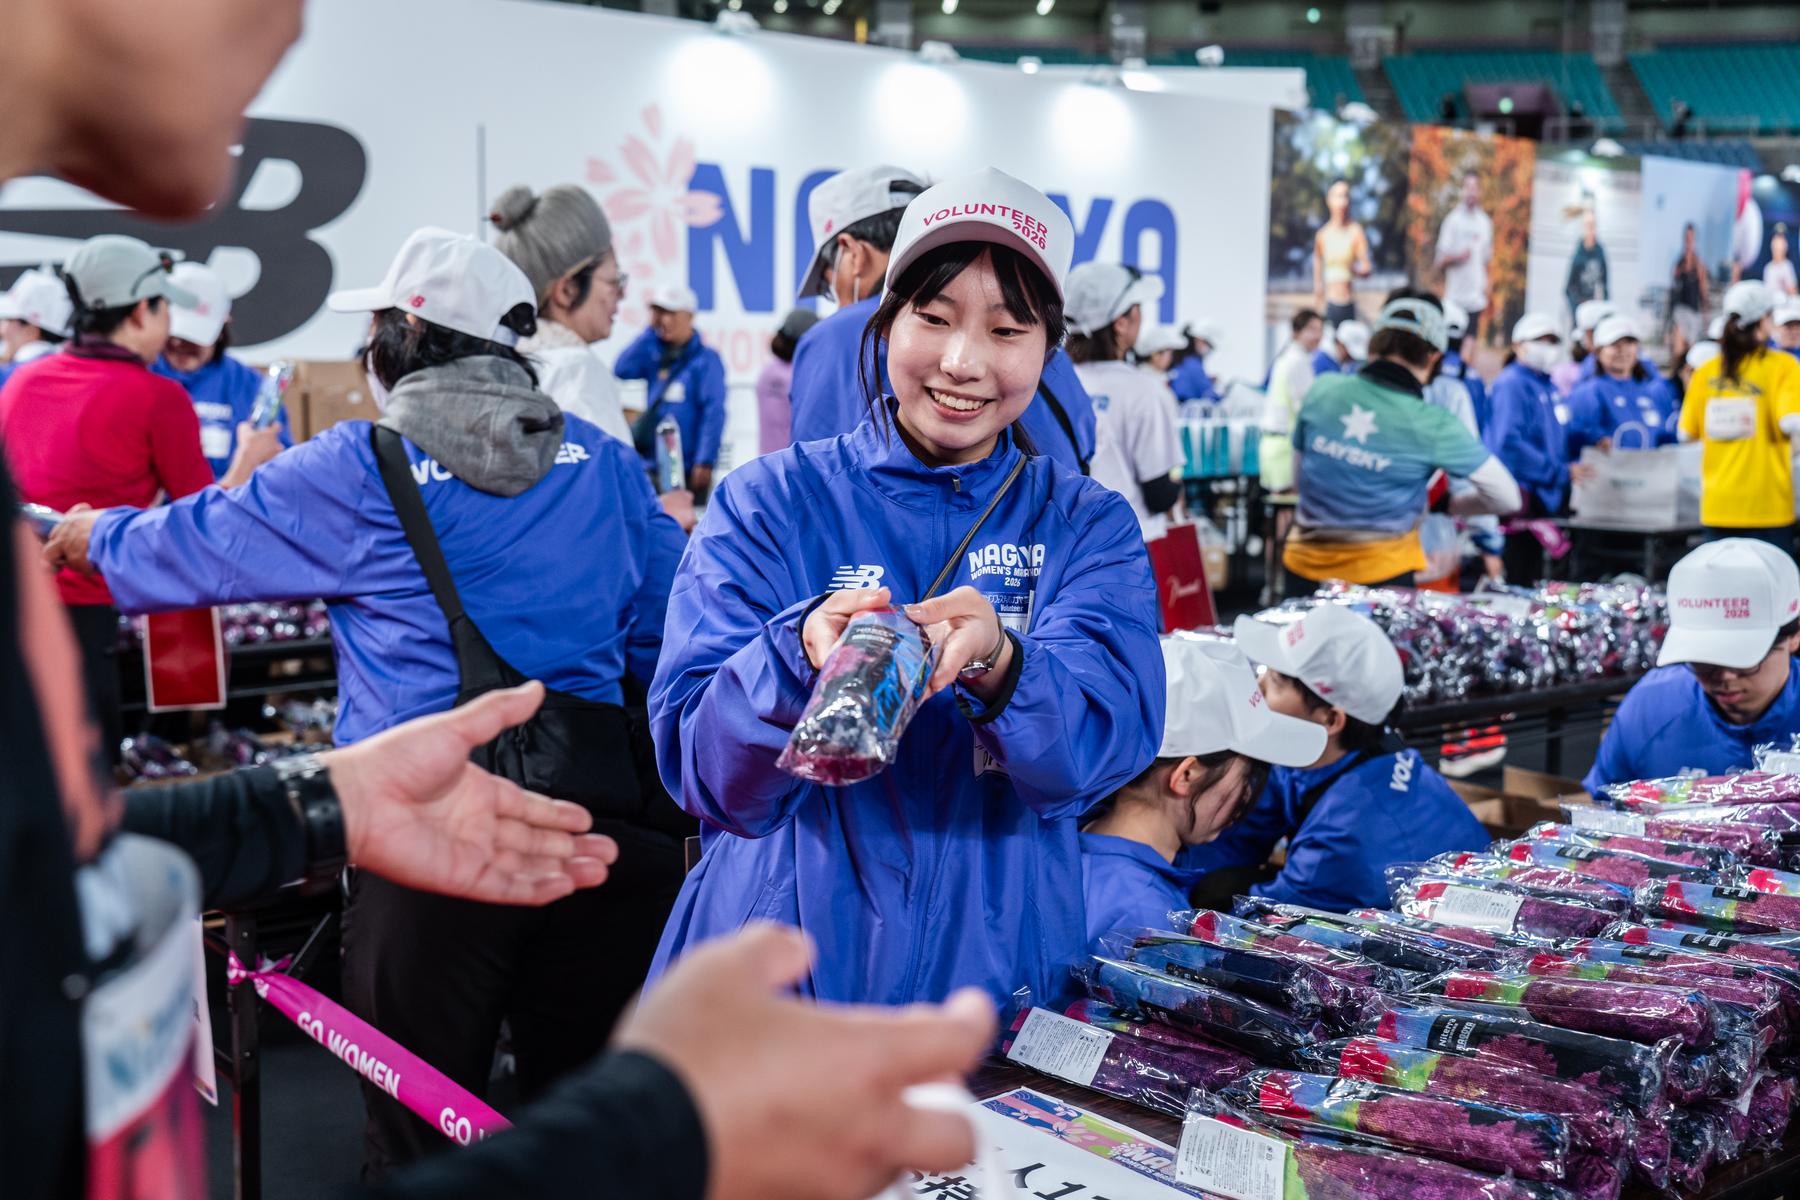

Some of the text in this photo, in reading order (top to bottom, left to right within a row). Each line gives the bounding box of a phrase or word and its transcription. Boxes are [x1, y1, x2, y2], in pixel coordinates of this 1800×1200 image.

[923, 203, 1048, 238] VOLUNTEER
[1012, 221, 1047, 250] 2026
[968, 543, 1046, 573] NAGYA
[970, 565, 1012, 581] WOMEN'S
[1677, 596, 1750, 610] VOLUNTEER
[1724, 608, 1750, 620] 2026
[1438, 1018, 1457, 1047] Niterra
[297, 1011, 400, 1100] GO WOMEN
[439, 1107, 473, 1147] GO
